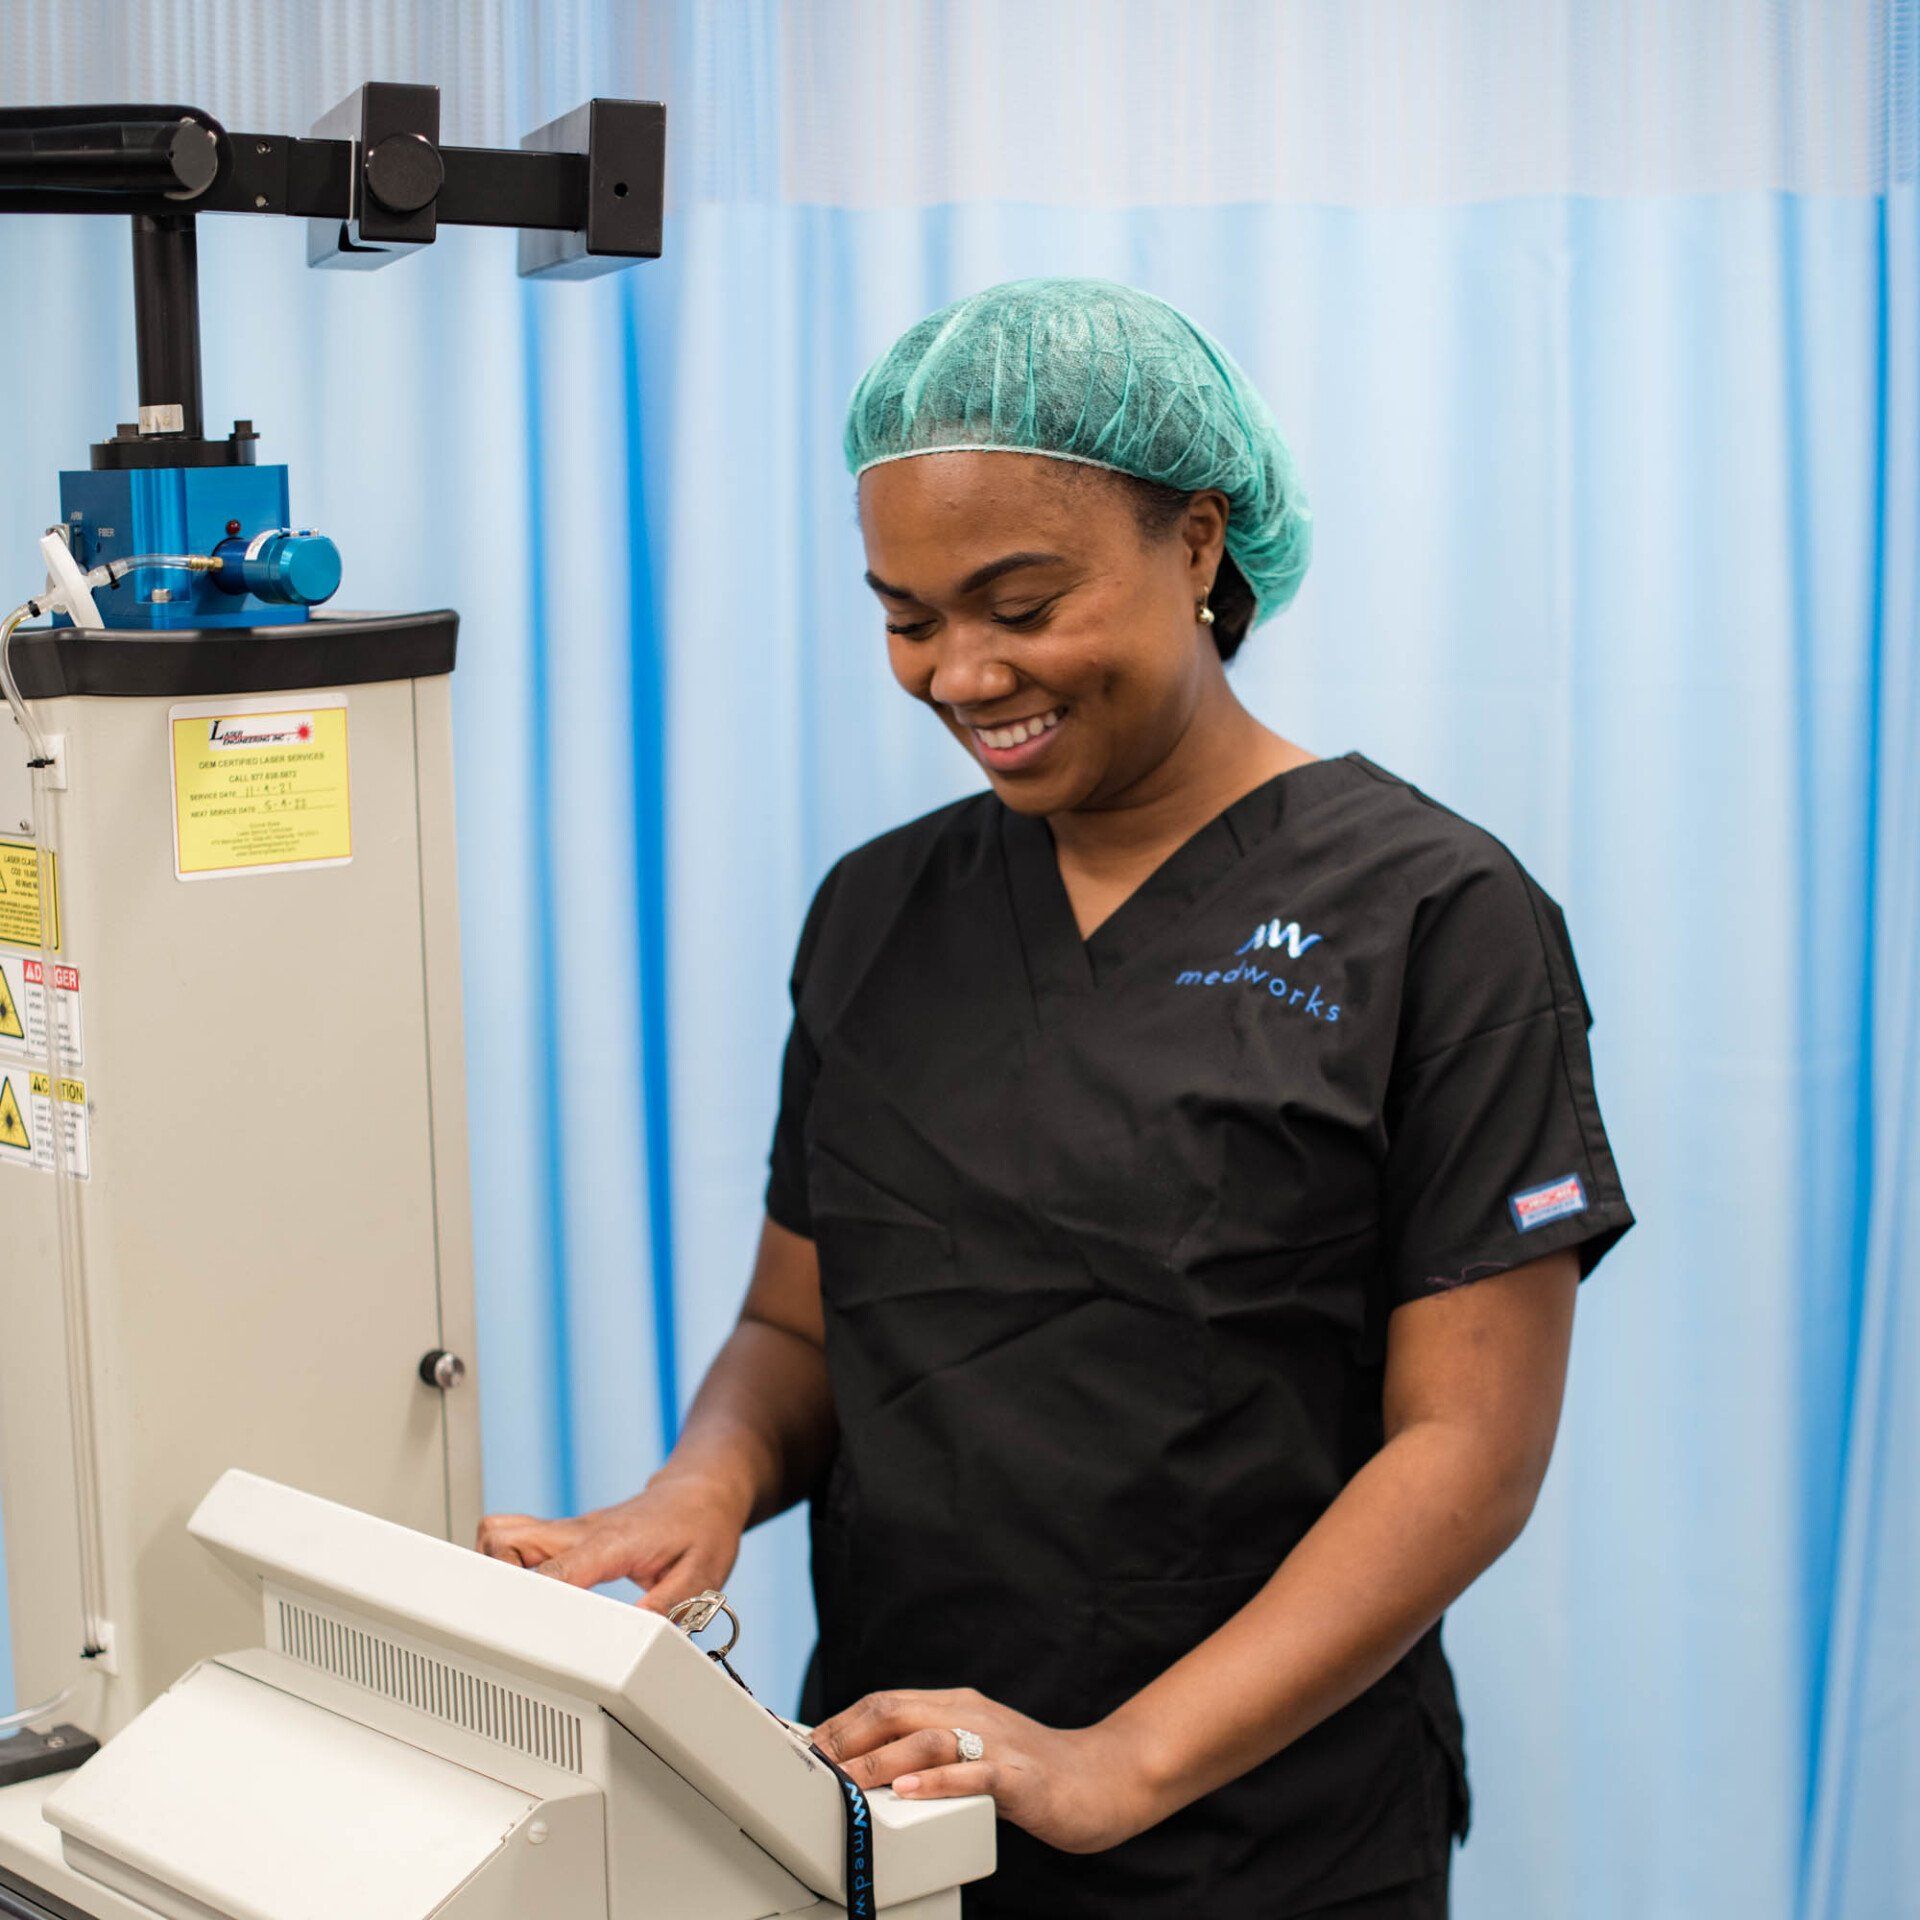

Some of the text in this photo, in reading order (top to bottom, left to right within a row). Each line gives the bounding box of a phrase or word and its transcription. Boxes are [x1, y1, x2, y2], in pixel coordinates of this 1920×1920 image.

[218, 757, 258, 768] CERTIFIED
[259, 754, 285, 765] LASER
[286, 751, 325, 762] SERVICES
[1174, 960, 1341, 1022] medworks
